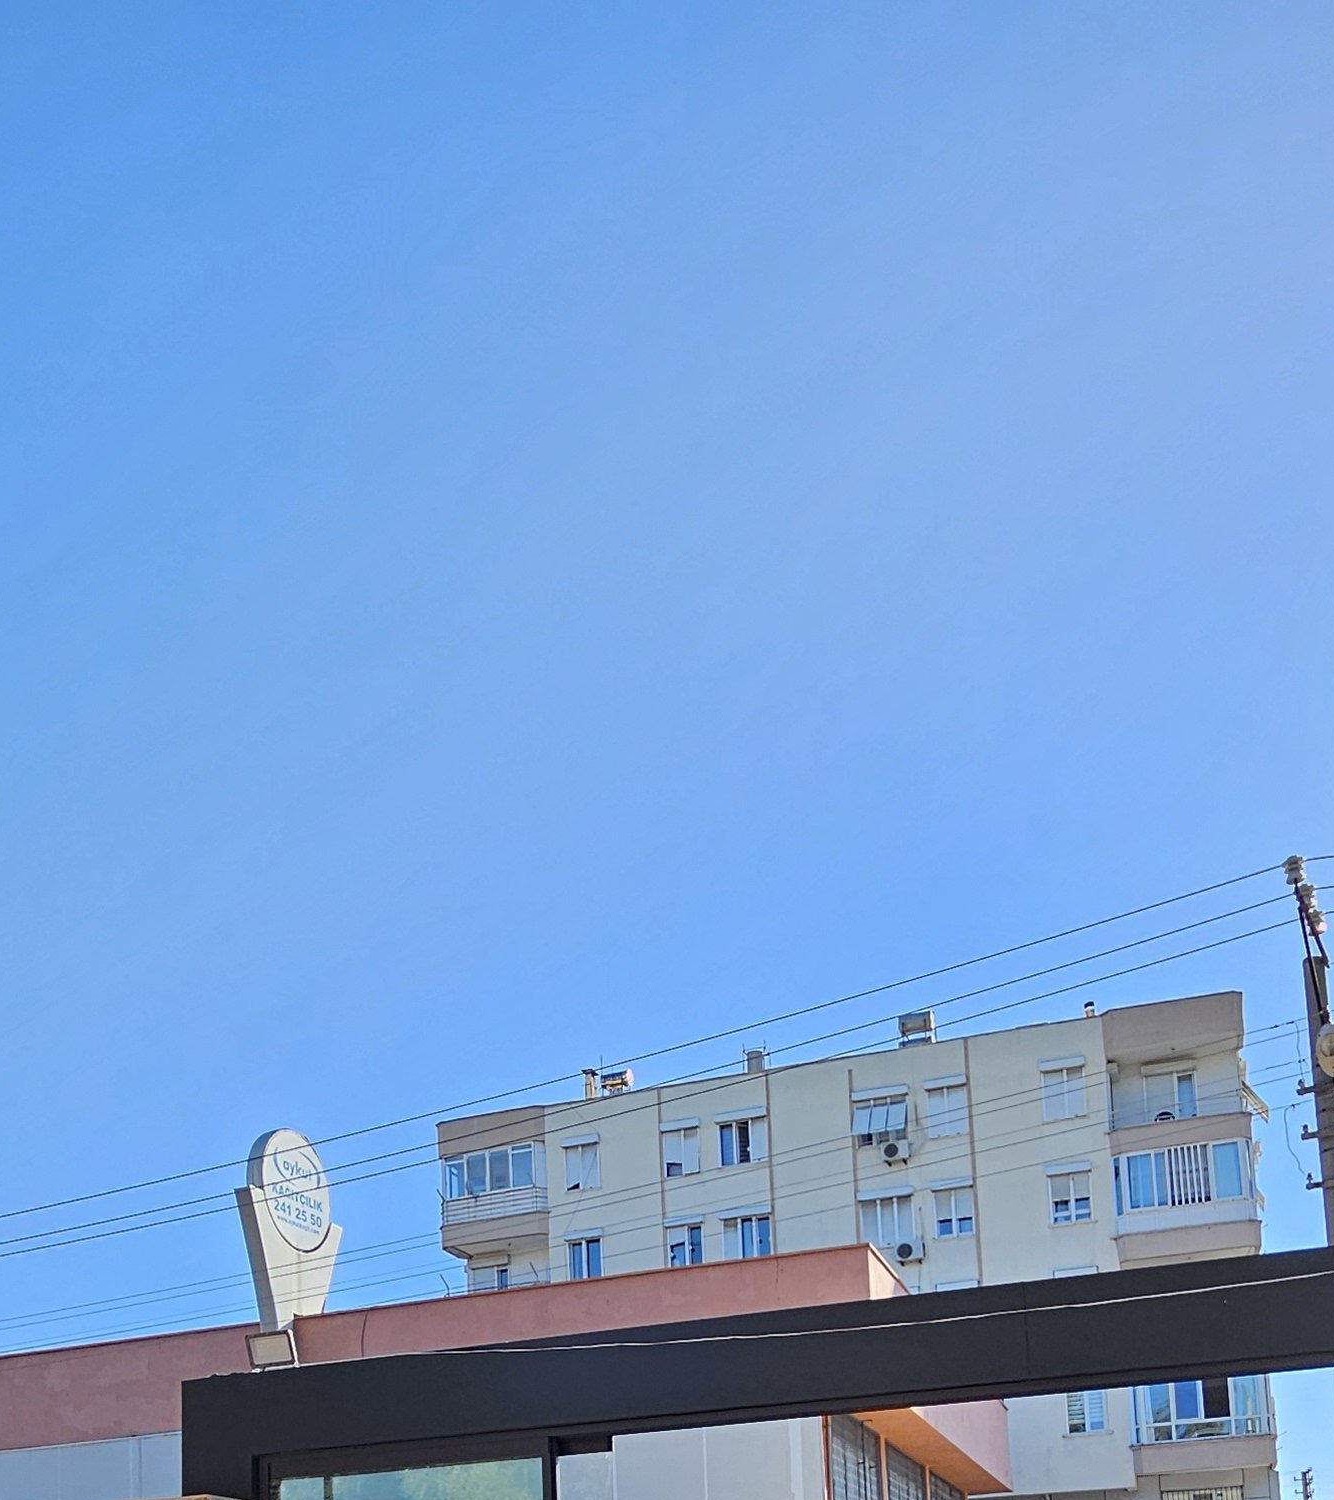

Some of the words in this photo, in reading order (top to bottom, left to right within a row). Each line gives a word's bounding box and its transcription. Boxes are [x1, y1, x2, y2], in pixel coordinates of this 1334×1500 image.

[274, 1200, 292, 1216] 241
[295, 1207, 308, 1222] 25
[310, 1213, 323, 1228] 50
